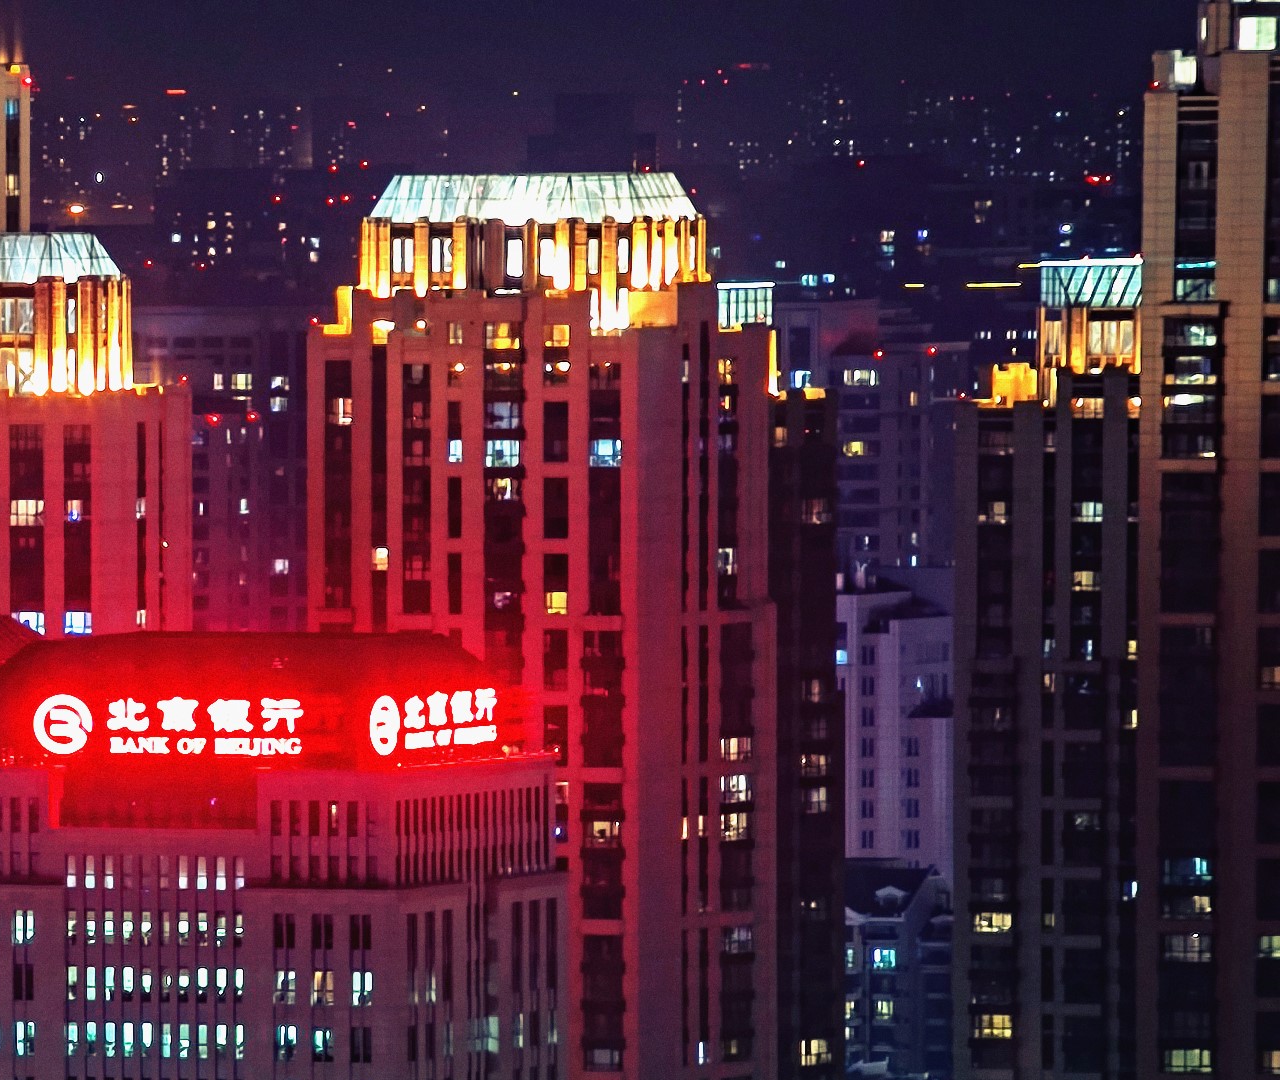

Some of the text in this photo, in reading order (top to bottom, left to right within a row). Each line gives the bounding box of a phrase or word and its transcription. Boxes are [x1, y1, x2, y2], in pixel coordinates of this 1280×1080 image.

[107, 697, 304, 732] 北京银行
[110, 737, 303, 757] BANK OF BEIJING
